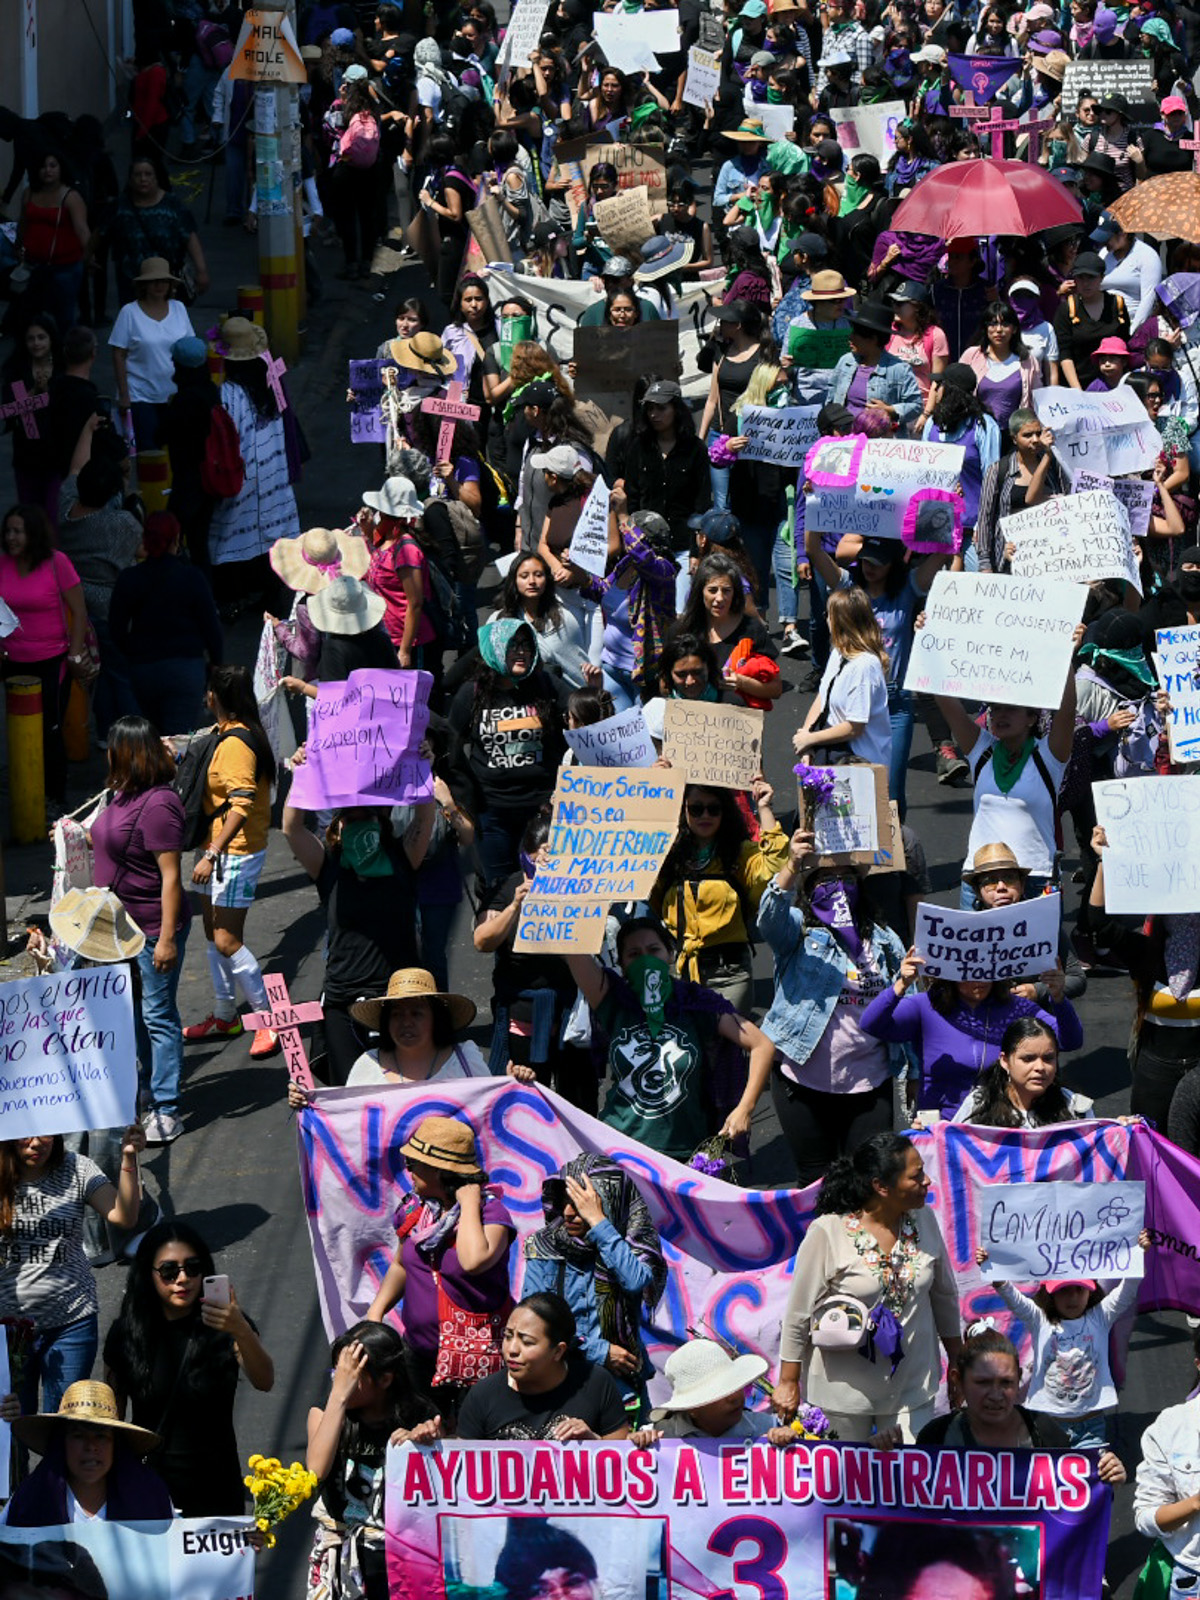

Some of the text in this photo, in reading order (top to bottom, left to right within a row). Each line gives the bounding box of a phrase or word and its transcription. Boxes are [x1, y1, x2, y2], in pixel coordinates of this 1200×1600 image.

[431, 401, 477, 417] MARISOL
[744, 410, 796, 430] Nunca se
[766, 430, 777, 443] la
[1068, 441, 1089, 457] TU
[867, 441, 945, 464] MARY
[1044, 500, 1061, 518] 8
[943, 580, 1045, 603] A NINGÚN
[931, 603, 1074, 634] HOMBRE CONSIENTO
[920, 633, 1030, 663] QUE DICTE MI
[947, 658, 1034, 686] SENTENCIA
[670, 701, 754, 736] Seguimos
[577, 719, 646, 749] Ni una menos
[616, 741, 648, 766] tocan
[665, 747, 678, 761] a
[684, 743, 700, 764] la
[559, 769, 675, 800] Señor, Señora
[557, 801, 626, 826] NO sea
[1101, 781, 1200, 821] SOMOS
[548, 826, 672, 857] INDIFERENTE
[1117, 819, 1192, 856] GRITO
[567, 857, 658, 876] MATA A LAS
[1114, 860, 1189, 892] QUE YA
[530, 876, 636, 896] MUJERES EN LA
[522, 902, 603, 920] CARA LA
[922, 914, 1028, 943] Tocan a
[986, 940, 1053, 964] tocan
[923, 960, 1029, 981] a todas
[40, 971, 128, 1009] el grito
[266, 984, 287, 1004] NI
[22, 1006, 87, 1032] las que
[261, 1008, 301, 1028] UNA
[42, 1025, 116, 1056] estan
[989, 1200, 1086, 1244] CAMINO
[1029, 1235, 1132, 1279] SEGURO
[403, 1447, 656, 1507] AYUDANOS
[673, 1447, 1093, 1513] A ENCONTRARLAS
[707, 1515, 789, 1599] 3
